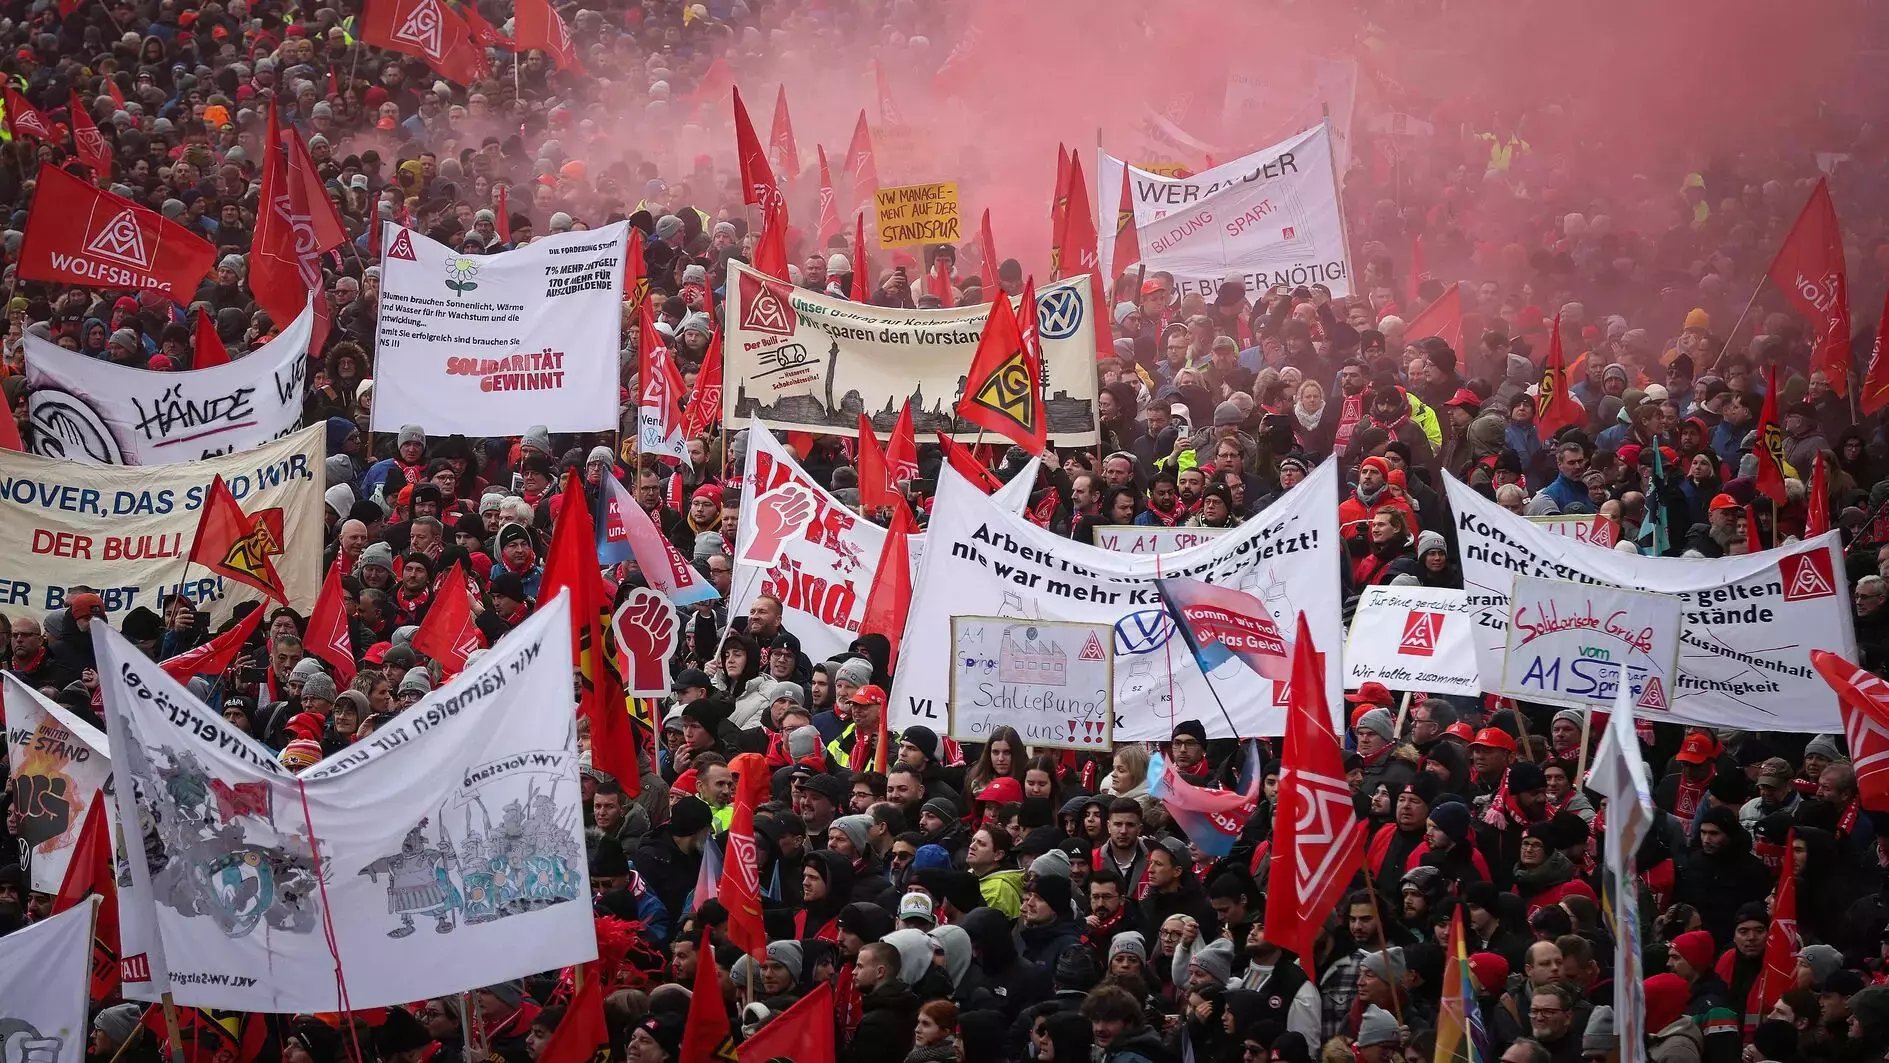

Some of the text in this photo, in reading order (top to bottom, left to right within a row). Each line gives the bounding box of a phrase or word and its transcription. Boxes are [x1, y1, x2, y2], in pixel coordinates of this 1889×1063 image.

[877, 186, 953, 206] VW MANAGE-
[1138, 181, 1200, 204] WER
[880, 202, 958, 221] MENT AUF DER
[882, 217, 960, 243] STANDSPUR
[1152, 200, 1278, 254] BILDUNG SPART,
[561, 245, 598, 254] FORDERUNG
[560, 264, 584, 274] MEHR
[570, 274, 592, 284] MEHR
[595, 269, 611, 280] FÜR
[1275, 261, 1347, 287] NÖTIG!
[546, 281, 612, 298] AUSZUBILDENDE
[396, 304, 421, 315] Wasser
[422, 308, 434, 317] für
[448, 311, 490, 322] Wachstum
[491, 314, 506, 322] und
[410, 295, 444, 306] brauchen
[446, 300, 495, 312] Sonnenlicht,
[792, 297, 828, 315] Unser
[399, 330, 410, 338] Sie
[412, 332, 452, 342] erfolgreich
[454, 336, 470, 344] sind
[472, 336, 508, 346] brauchen
[798, 312, 985, 345] Wir sparen den Vorstan
[744, 336, 778, 352] Der Bulli
[446, 348, 564, 376] SOLIDARITÄT
[480, 372, 564, 392] GEWINNT
[132, 384, 255, 439] HÄNDE
[112, 489, 176, 515] DAS
[256, 453, 314, 490] WIR,
[32, 528, 183, 560] DER BULLI,
[972, 522, 1054, 568] Arbeit
[1101, 536, 1121, 552] VL
[1131, 535, 1158, 554] A1
[952, 541, 988, 568] nie
[994, 561, 1042, 588] war
[1046, 579, 1121, 604] mehr
[1254, 529, 1318, 567] jetzt!
[761, 553, 860, 632] Sind.
[1468, 543, 1530, 575] nicht
[1682, 604, 1774, 625] stände
[1697, 581, 1782, 608] gelten
[1369, 590, 1388, 608] Für
[1411, 599, 1456, 612] gerechte
[1466, 593, 1511, 606] erant
[1184, 609, 1234, 625] Komm,
[1234, 618, 1254, 630] wir
[1515, 599, 1600, 644] Solidarische
[1218, 632, 1243, 646] das
[1247, 635, 1283, 653] Geld!
[1578, 646, 1610, 660] vom
[958, 651, 1000, 675] Springe
[1680, 629, 1814, 680] Zusammenhalt
[1352, 664, 1374, 678] Wir
[1415, 672, 1478, 688] zusammen!
[1521, 656, 1560, 691] A1
[1675, 675, 1780, 696] frichtigkeit
[910, 698, 938, 719] VL
[974, 683, 1107, 727] Schließung?
[10, 727, 90, 762] WE STAND
[39, 726, 70, 741] UNITED
